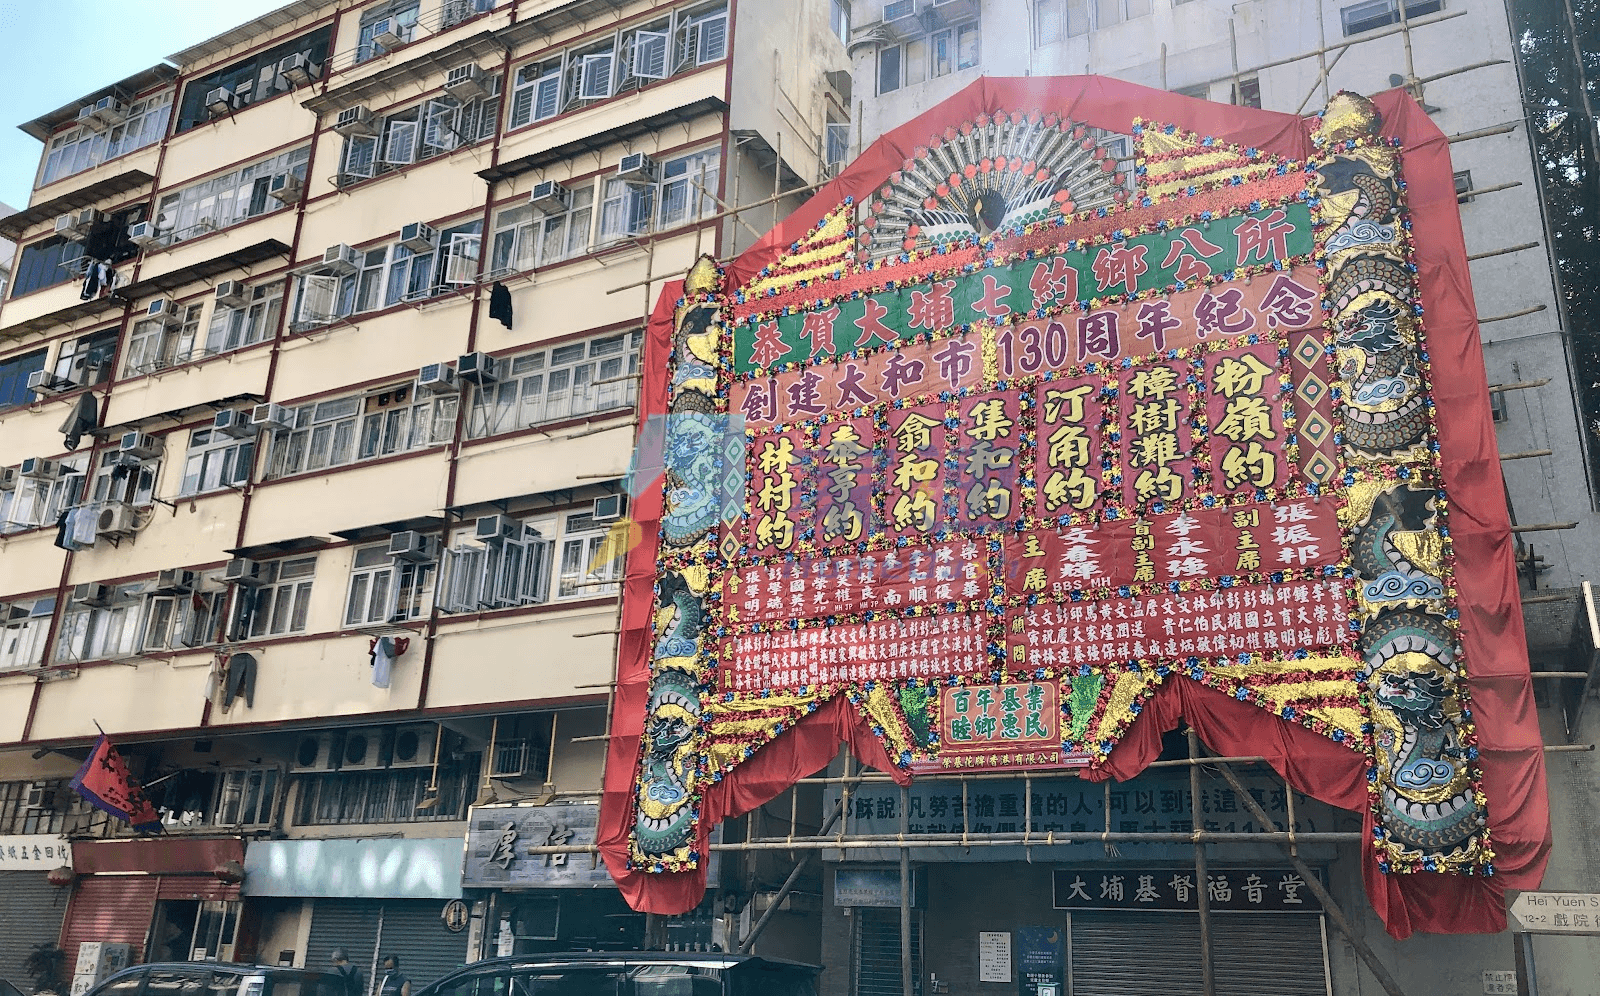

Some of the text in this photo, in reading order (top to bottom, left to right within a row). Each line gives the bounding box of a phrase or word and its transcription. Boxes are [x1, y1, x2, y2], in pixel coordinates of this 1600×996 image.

[751, 208, 1296, 371] 恭賀大埔七約鄉公所
[1042, 382, 1101, 514] 汀角約
[1126, 363, 1187, 506] 樟樹灘約
[1211, 351, 1279, 494] 粉嶺約
[820, 425, 869, 544] 泰亨約
[964, 397, 1016, 523] 集和約
[755, 436, 801, 553] 林村約
[1022, 535, 1048, 592] 主席
[1058, 527, 1103, 580] 文春輝
[1129, 519, 1156, 583] 首副主席
[1165, 515, 1211, 577] 李永強
[1232, 508, 1261, 571] 副主席
[1053, 577, 1111, 592] BBS MH
[950, 711, 1048, 741] 睦鄉惠民
[951, 685, 1046, 713] 百年基業
[1066, 872, 1307, 905] 大埔基督福音堂
[1524, 914, 1547, 923] 12-2
[1527, 895, 1548, 906] Hei
[1552, 895, 1586, 907] Yuen
